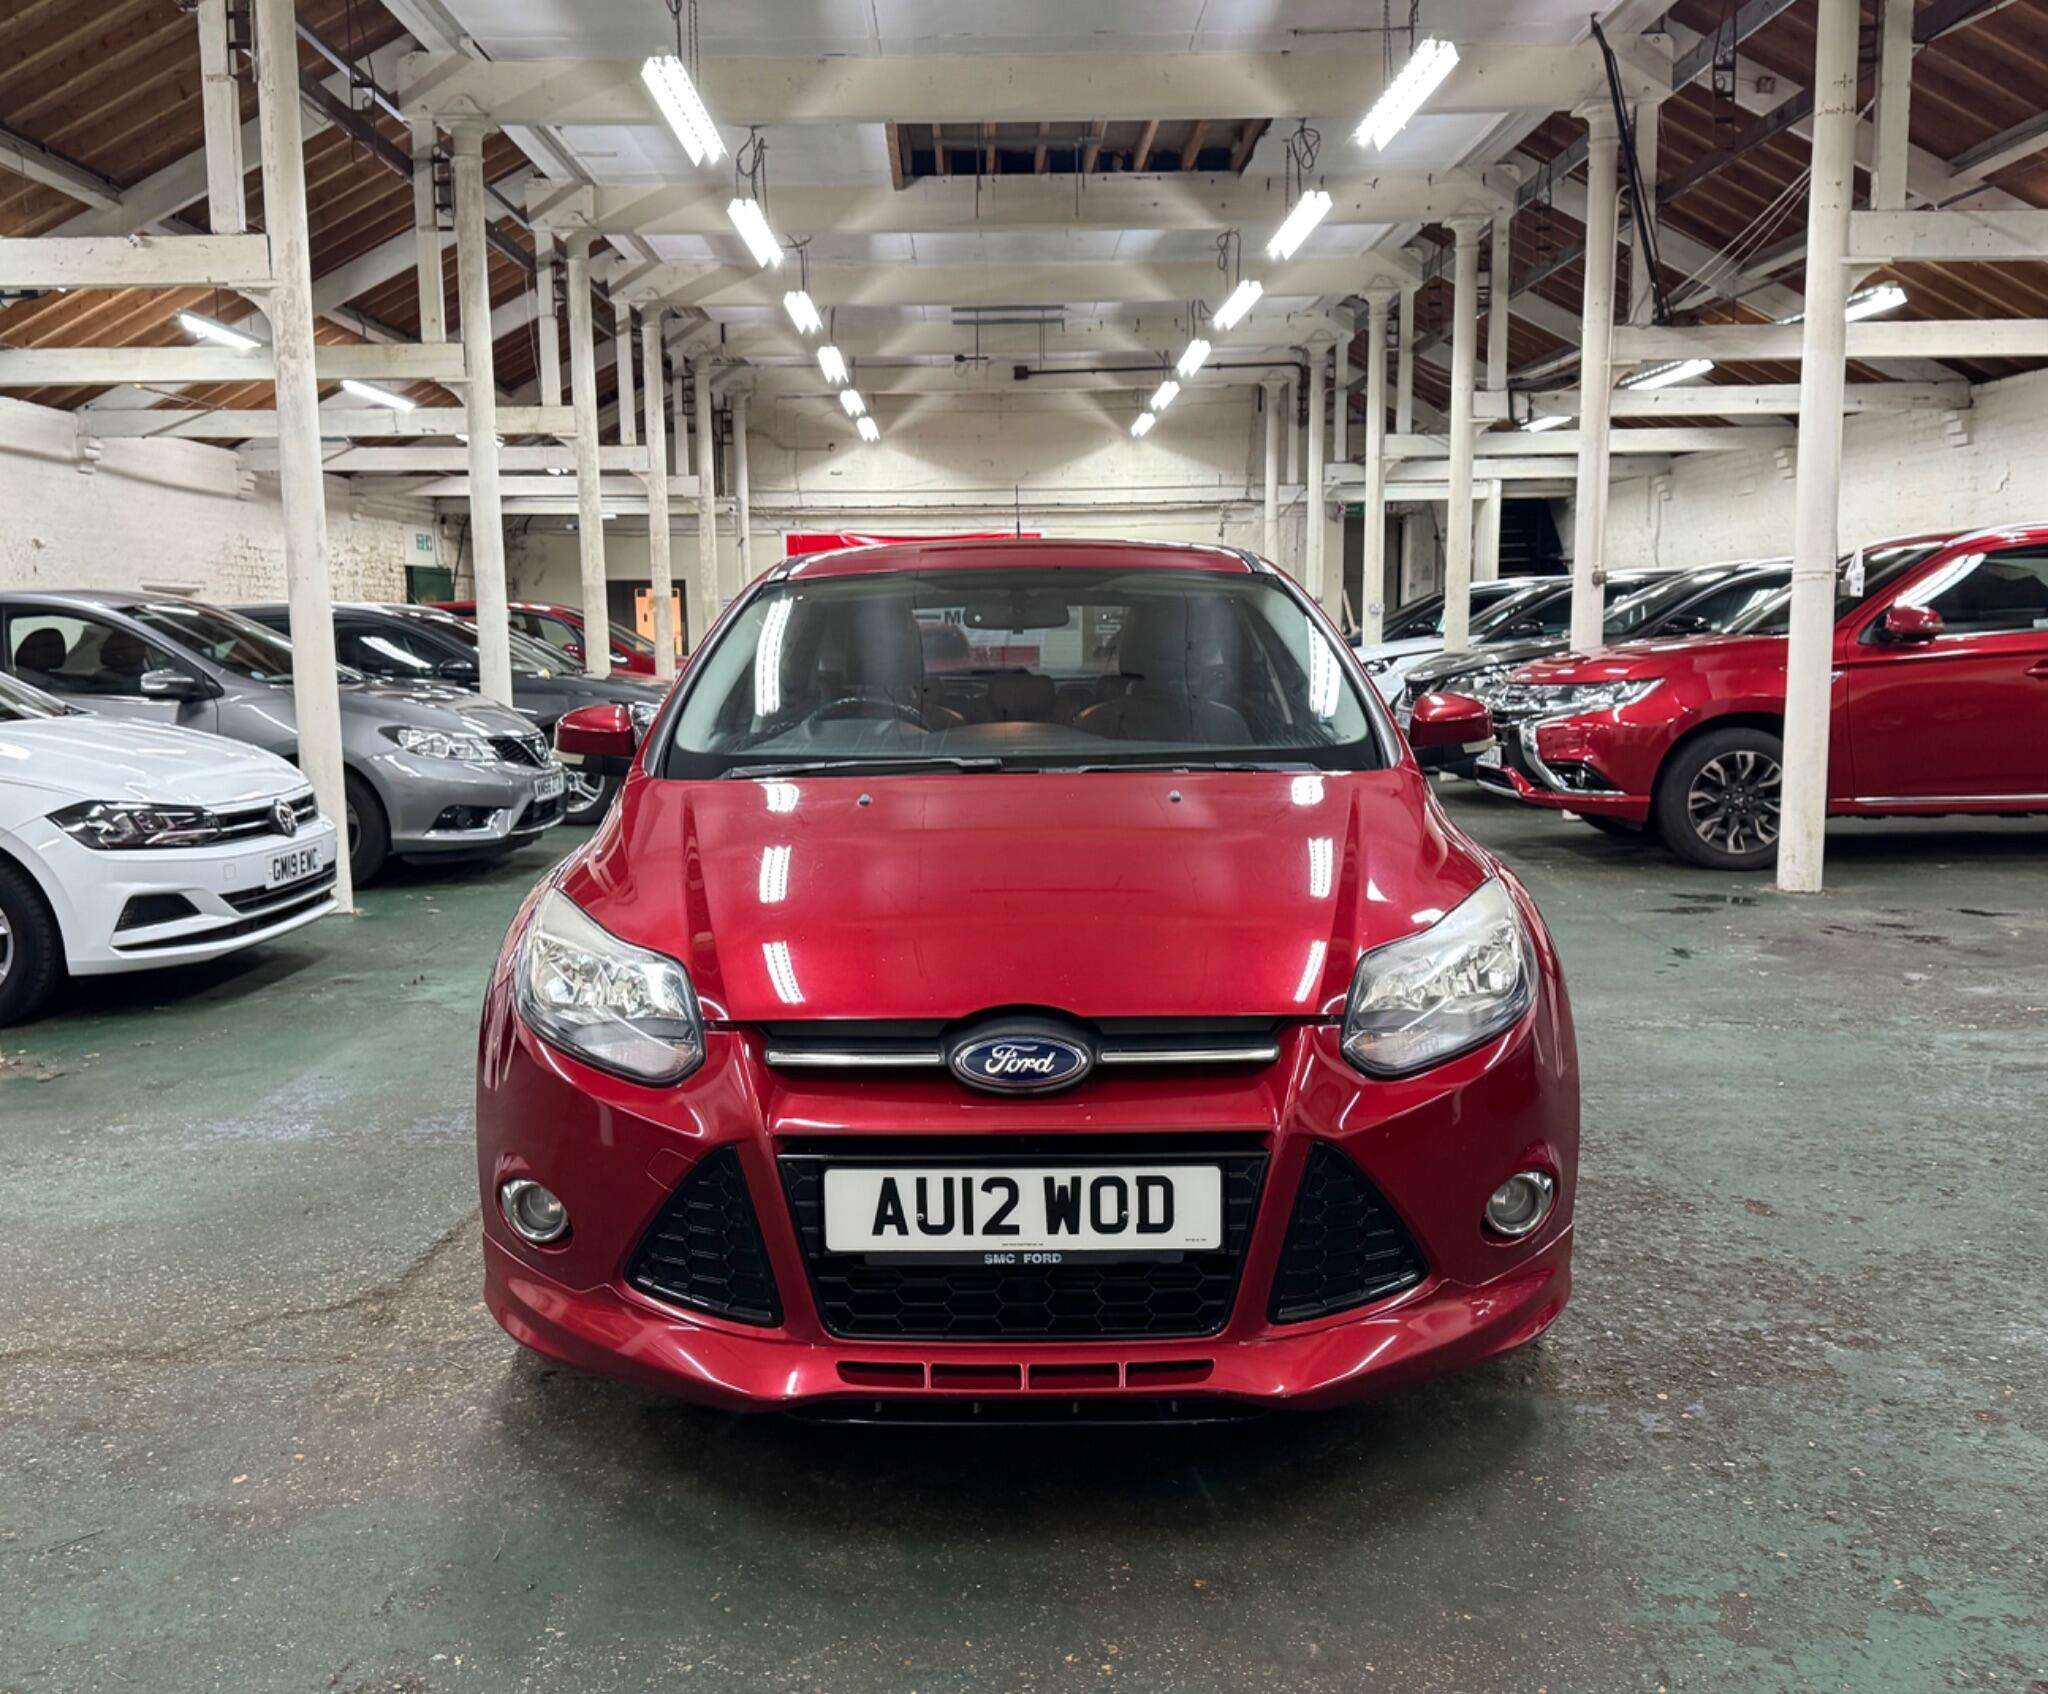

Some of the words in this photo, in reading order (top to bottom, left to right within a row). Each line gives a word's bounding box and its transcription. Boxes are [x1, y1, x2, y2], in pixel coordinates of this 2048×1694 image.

[273, 853, 298, 881] GM19
[985, 1044, 1056, 1073] Ford
[872, 1176, 1020, 1236] AU12
[1043, 1175, 1175, 1235] WOD
[984, 1253, 1017, 1265] SMC
[1023, 1253, 1063, 1264] FORD
